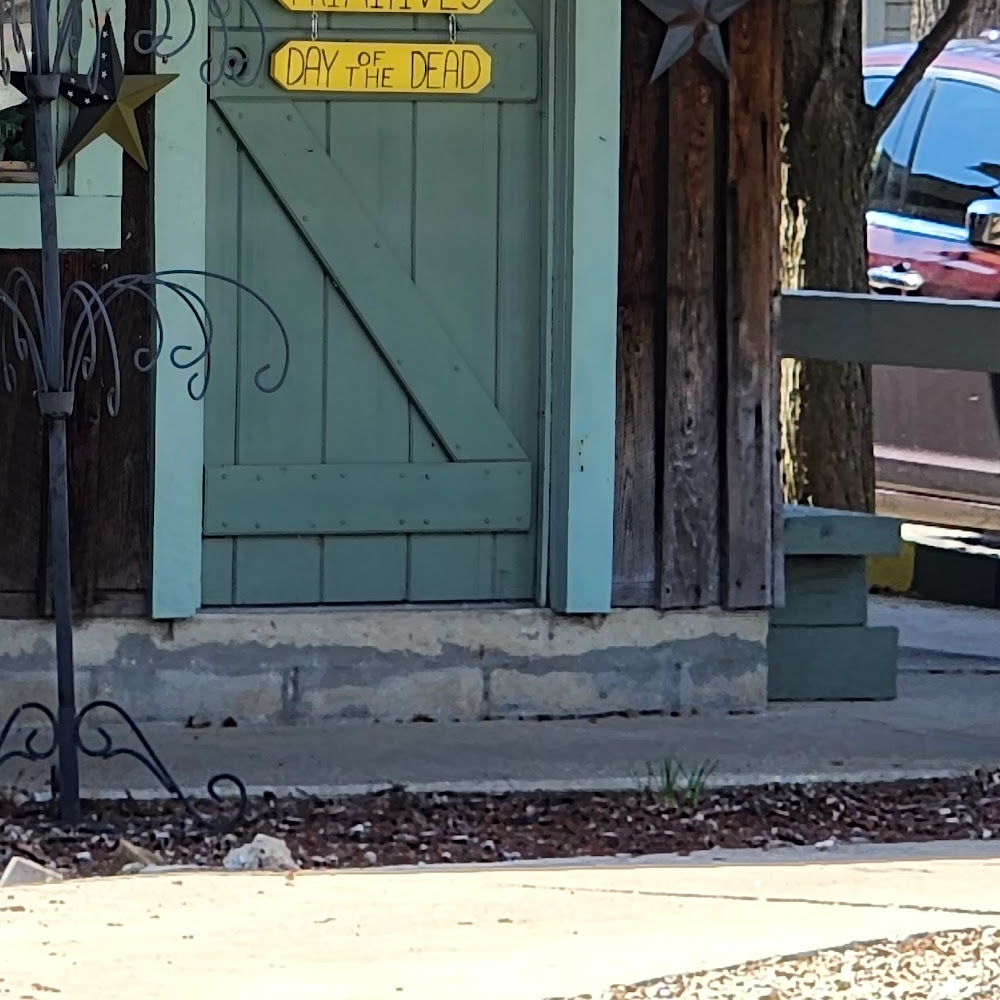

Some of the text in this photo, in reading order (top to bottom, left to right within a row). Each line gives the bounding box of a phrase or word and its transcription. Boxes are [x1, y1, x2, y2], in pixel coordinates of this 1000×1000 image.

[286, 46, 482, 90] DAY OF THE DEAD
